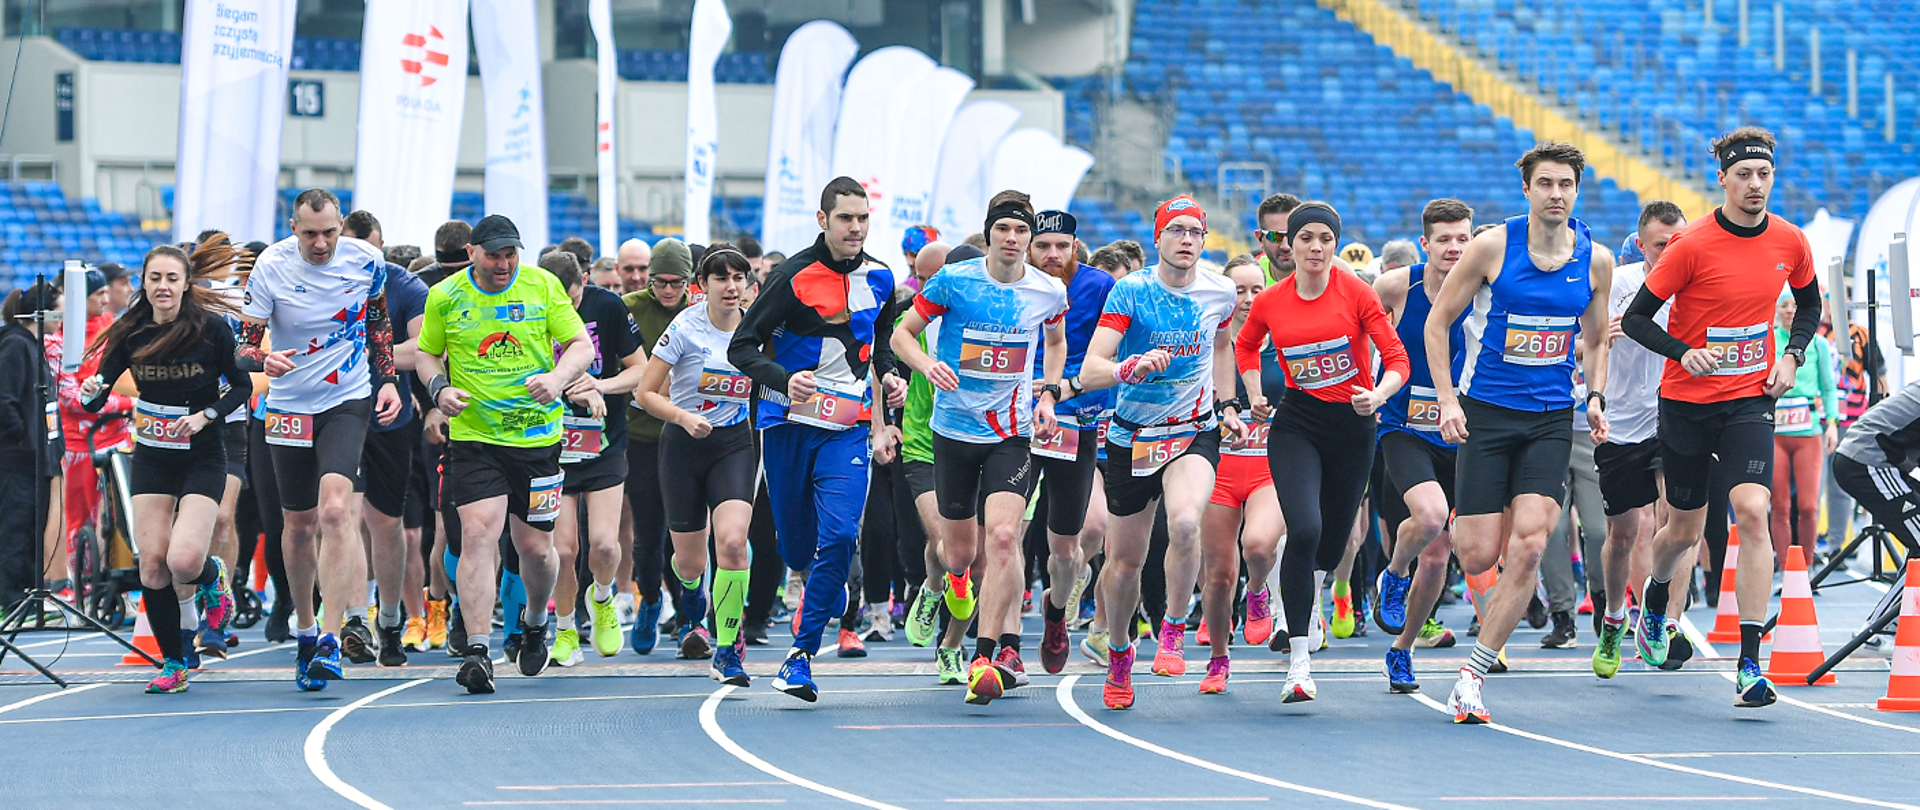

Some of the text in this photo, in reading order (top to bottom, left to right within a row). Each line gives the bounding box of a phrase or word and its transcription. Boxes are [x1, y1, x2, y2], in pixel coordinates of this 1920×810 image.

[292, 83, 321, 116] 15
[1347, 250, 1365, 262] W
[1149, 330, 1208, 344] HERNIK
[1512, 333, 1565, 353] 2661
[981, 349, 1010, 369] 65
[1292, 353, 1351, 380] 2596
[132, 363, 205, 381] NEBBIA
[814, 395, 837, 417] 19
[269, 416, 302, 435] 259
